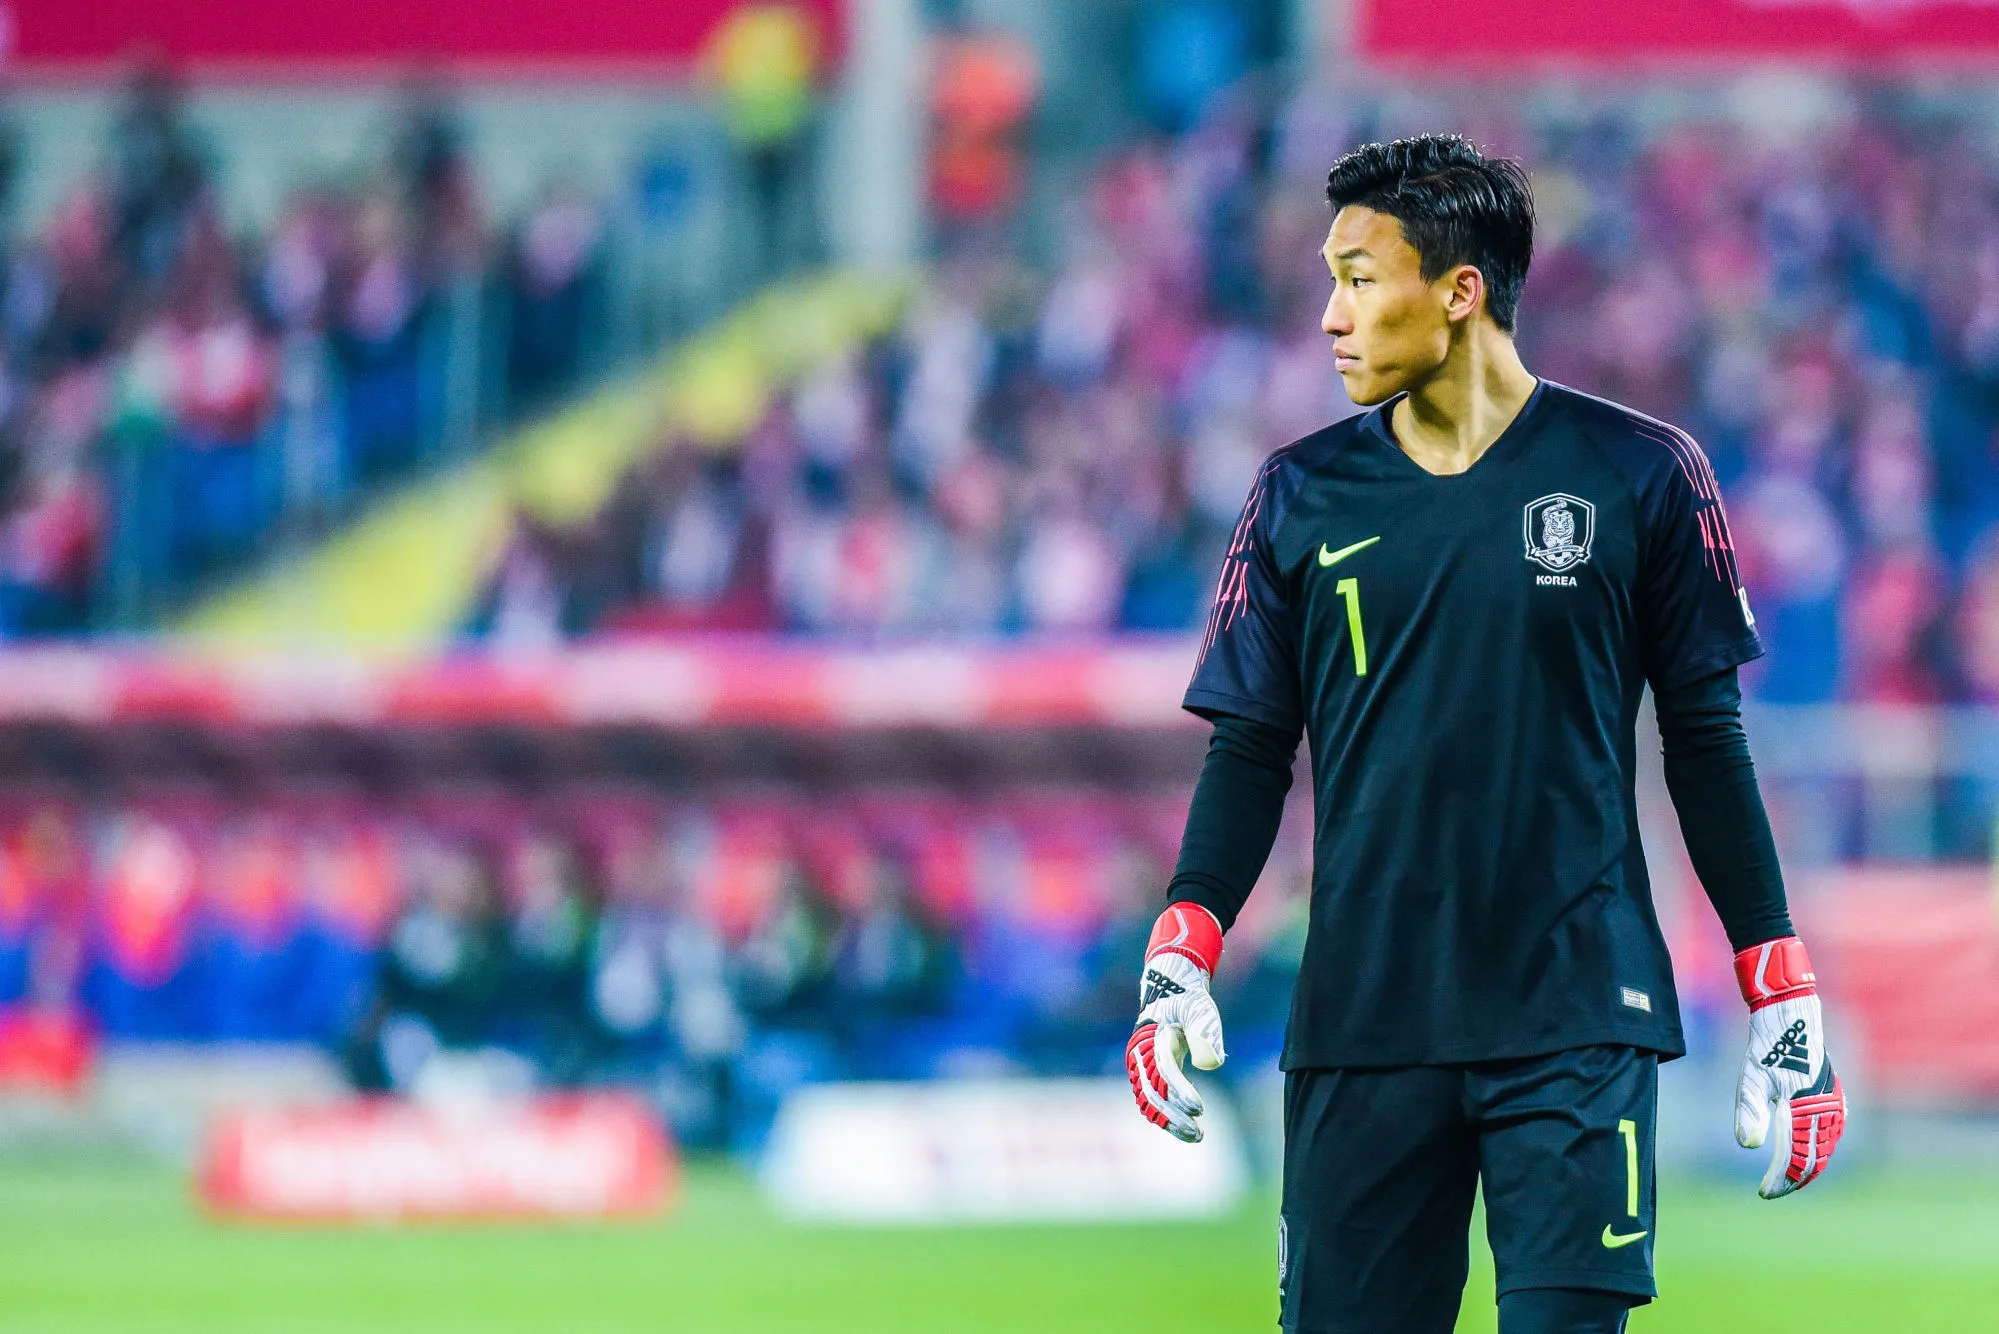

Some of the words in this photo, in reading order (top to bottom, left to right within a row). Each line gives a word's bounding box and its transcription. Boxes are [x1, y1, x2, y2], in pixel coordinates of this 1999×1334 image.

[1536, 575, 1577, 587] KOREA
[1336, 577, 1367, 676] 1
[1761, 1018, 1806, 1067] adidas
[1618, 1118, 1639, 1217] 1
